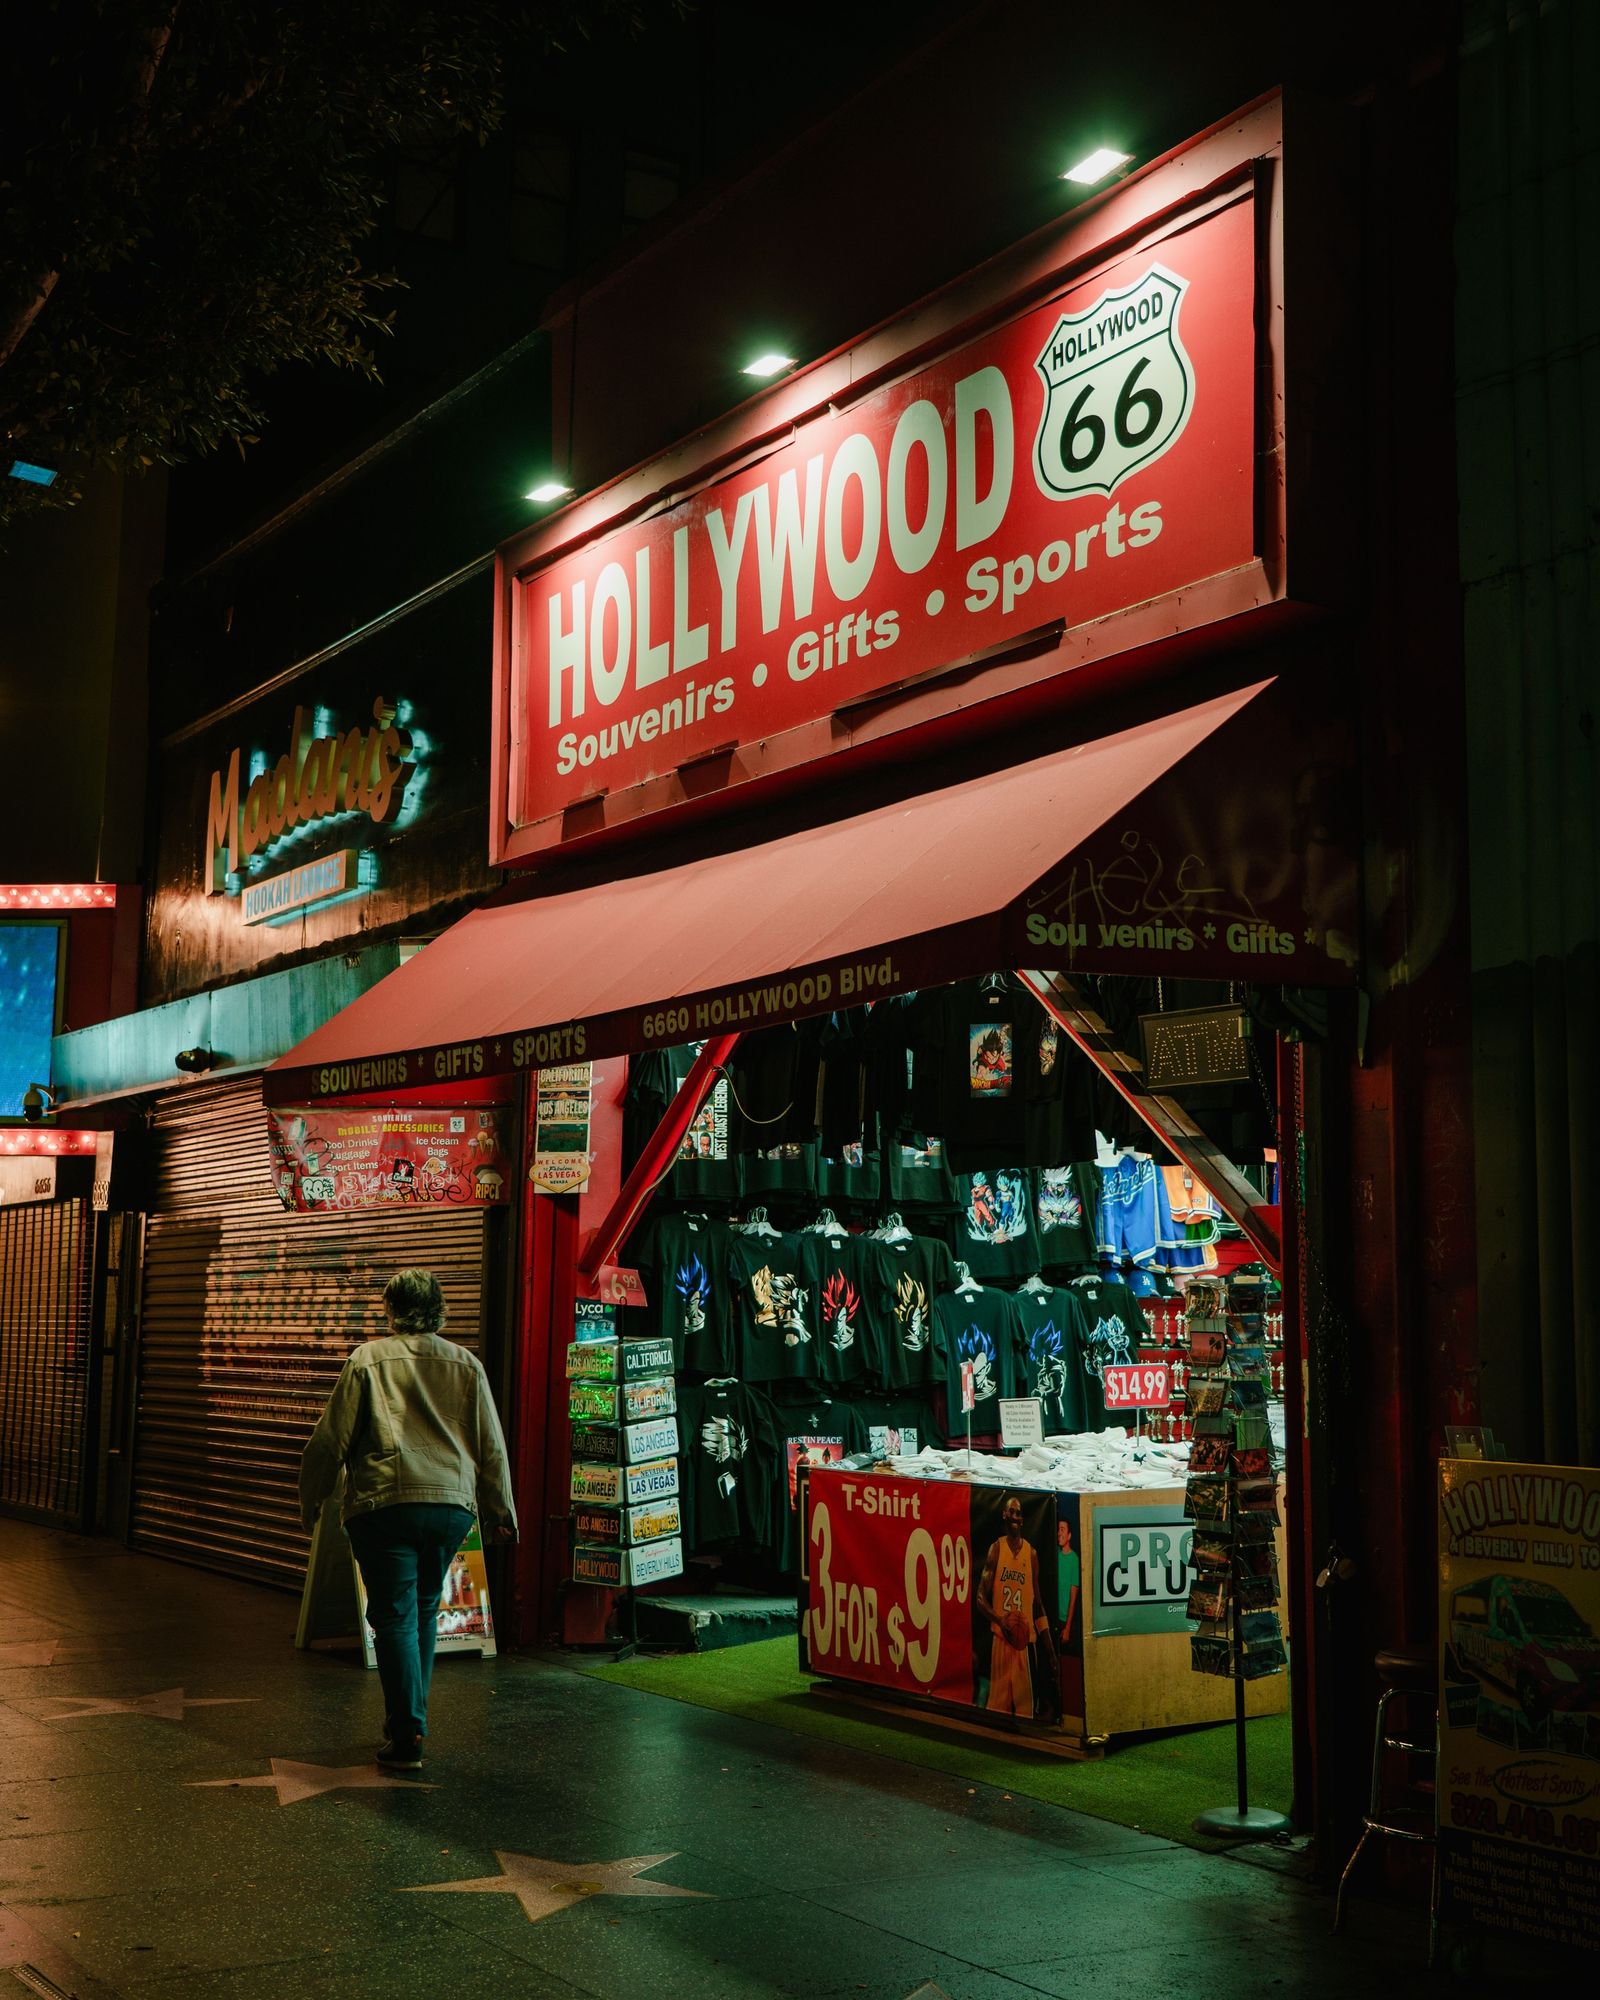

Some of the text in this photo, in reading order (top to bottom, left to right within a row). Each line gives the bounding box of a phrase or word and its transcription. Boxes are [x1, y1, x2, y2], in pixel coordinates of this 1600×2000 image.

[1051, 291, 1163, 370] HOLLYWOOD
[1060, 358, 1163, 474] 66
[548, 365, 1014, 729] HOLLYWOOD
[557, 501, 1163, 775] Souvenirs Gifts Sports
[246, 857, 340, 919] HOOKAH LOUNGE
[1226, 923, 1295, 955] Gifts
[643, 957, 900, 1039] 6660 HOLLYWOOD Blvd.
[319, 1024, 587, 1095] SOUVENIRS GIFTS SPORTS
[1150, 1016, 1247, 1080] ATM
[540, 1067, 589, 1082] CALIFORNIA
[337, 1125, 378, 1137] MOBILE
[715, 1115, 728, 1138] COAST
[349, 1138, 379, 1147] Drinks
[416, 1137, 459, 1145] Ice Cream
[427, 1147, 449, 1157] Bags
[715, 1139, 728, 1160] WEST
[331, 1149, 370, 1160] Luggage
[354, 1161, 379, 1170] Items
[575, 1302, 604, 1316] Lyca
[626, 1350, 673, 1370] CALIFORNIA
[1107, 1370, 1167, 1406] $14.99
[571, 1399, 583, 1411] LOS
[628, 1392, 674, 1411] CALIFORNIA
[631, 1437, 645, 1455] LOS
[646, 1430, 676, 1451] ANGELES
[787, 1435, 842, 1445] REST IN PEACE
[631, 1479, 646, 1495] LAS
[648, 1474, 676, 1490] VEGAS
[641, 1467, 665, 1478] NEVADA
[574, 1481, 616, 1497] LOS ANGELES
[842, 1483, 921, 1520] T-Shirt
[577, 1515, 590, 1531] LOS
[590, 1517, 619, 1535] ANGELES
[1466, 1536, 1527, 1563] BEVERLY
[1533, 1540, 1573, 1567] HILLS
[577, 1558, 619, 1580] HOLLYWOOD
[811, 1501, 832, 1656] 3
[833, 1582, 880, 1666] FOR
[1003, 1586, 1021, 1612] 24
[1449, 1765, 1471, 1785] See
[1474, 1767, 1490, 1787] the
[1500, 1768, 1548, 1792] Hottest
[1549, 1774, 1586, 1799] Spots
[1472, 1840, 1529, 1864] Mulholland
[1449, 1850, 1469, 1867] The
[1472, 1856, 1526, 1881] Hollywood
[1558, 1877, 1597, 1896] Sunset
[1491, 1879, 1531, 1903] Beverly
[1453, 1886, 1494, 1906] Chinese
[1544, 1907, 1579, 1929] Kodak
[1472, 1907, 1510, 1929] Capitol
[1512, 1917, 1557, 1942] Records
